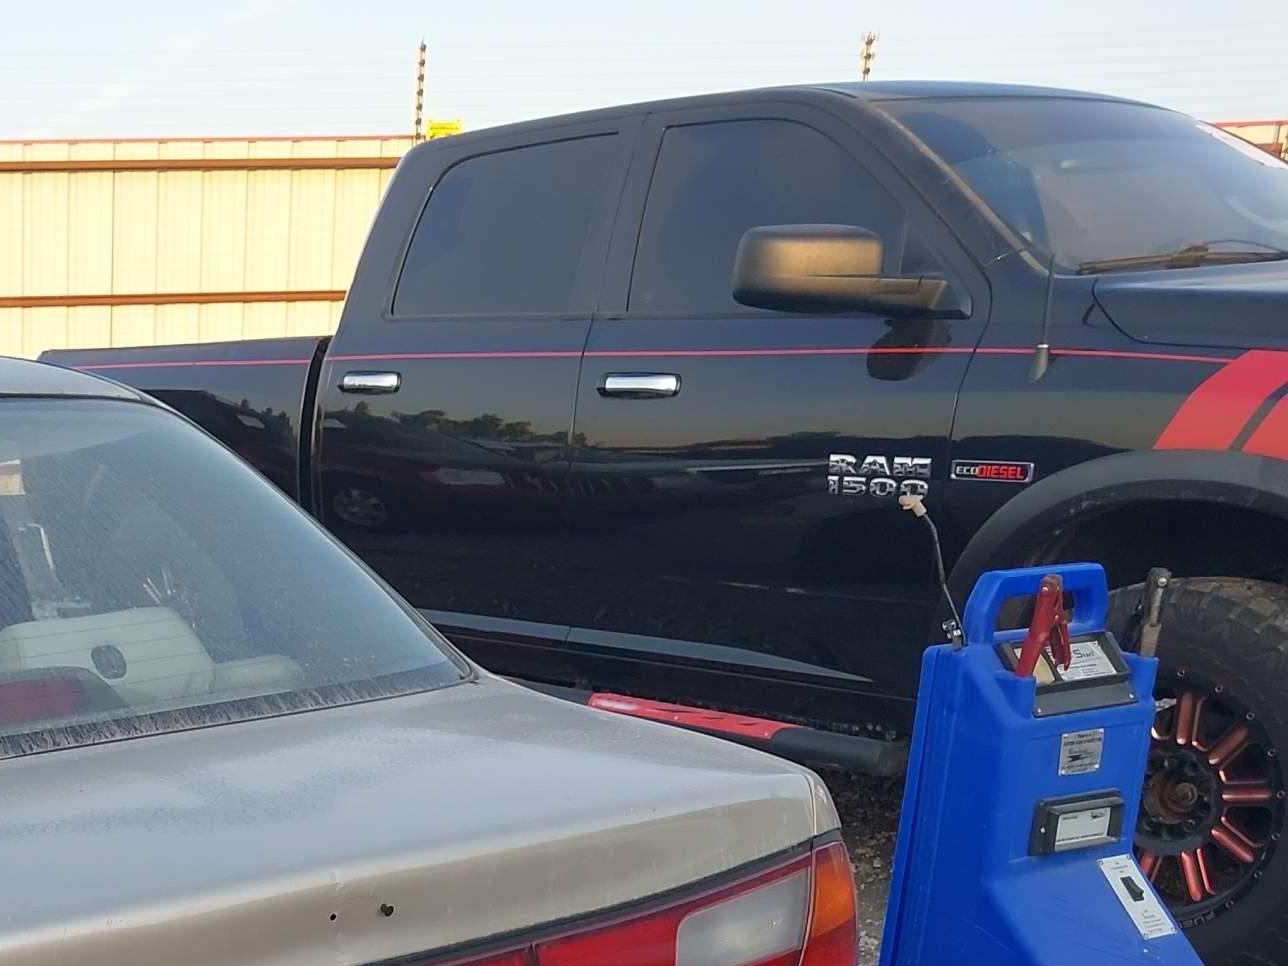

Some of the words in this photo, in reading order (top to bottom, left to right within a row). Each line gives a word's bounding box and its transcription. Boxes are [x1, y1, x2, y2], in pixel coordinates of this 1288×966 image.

[828, 453, 932, 478] RAM
[955, 465, 1025, 479] ECODIESEL
[827, 475, 929, 499] 1500
